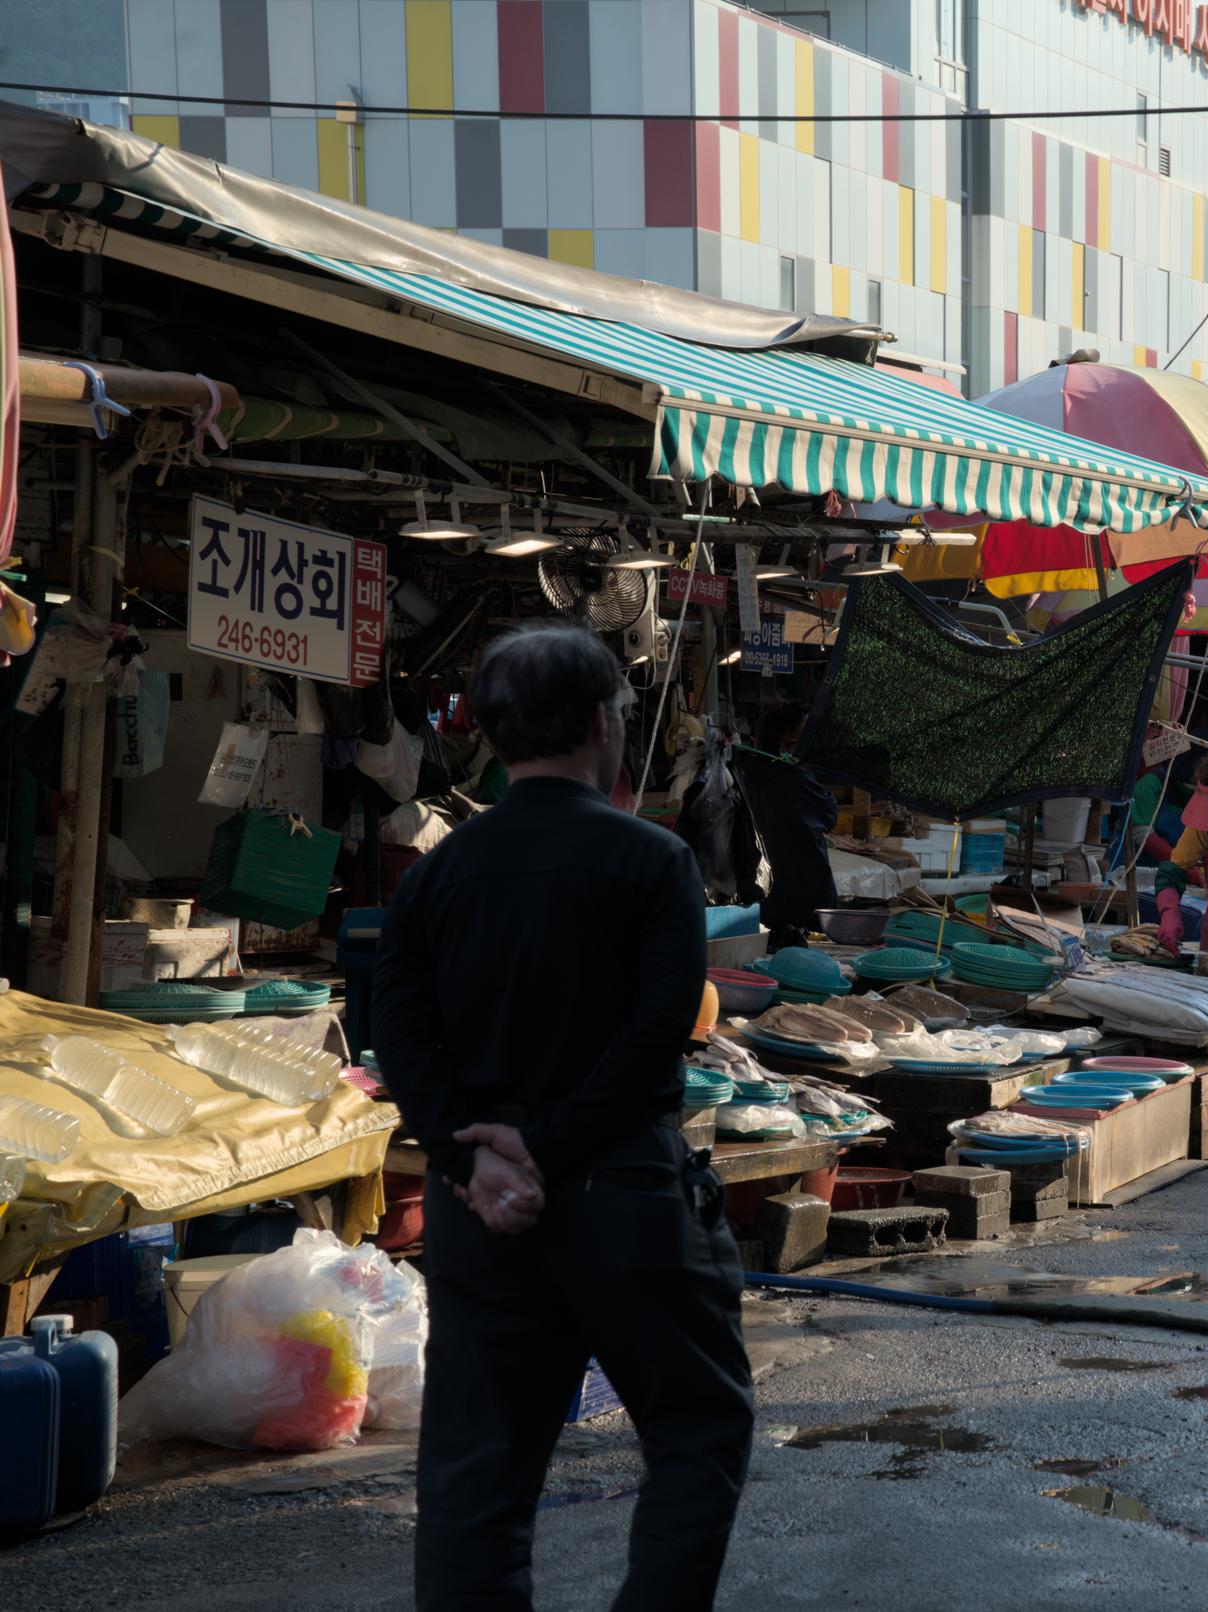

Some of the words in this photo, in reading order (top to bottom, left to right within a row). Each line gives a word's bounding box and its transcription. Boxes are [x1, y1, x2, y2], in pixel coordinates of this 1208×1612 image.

[196, 515, 347, 632] 조개상회
[670, 575, 725, 600] CCV녹화중
[216, 614, 308, 667] 246-6931
[352, 545, 383, 682] 택배전문
[117, 694, 140, 766] Bacchu
